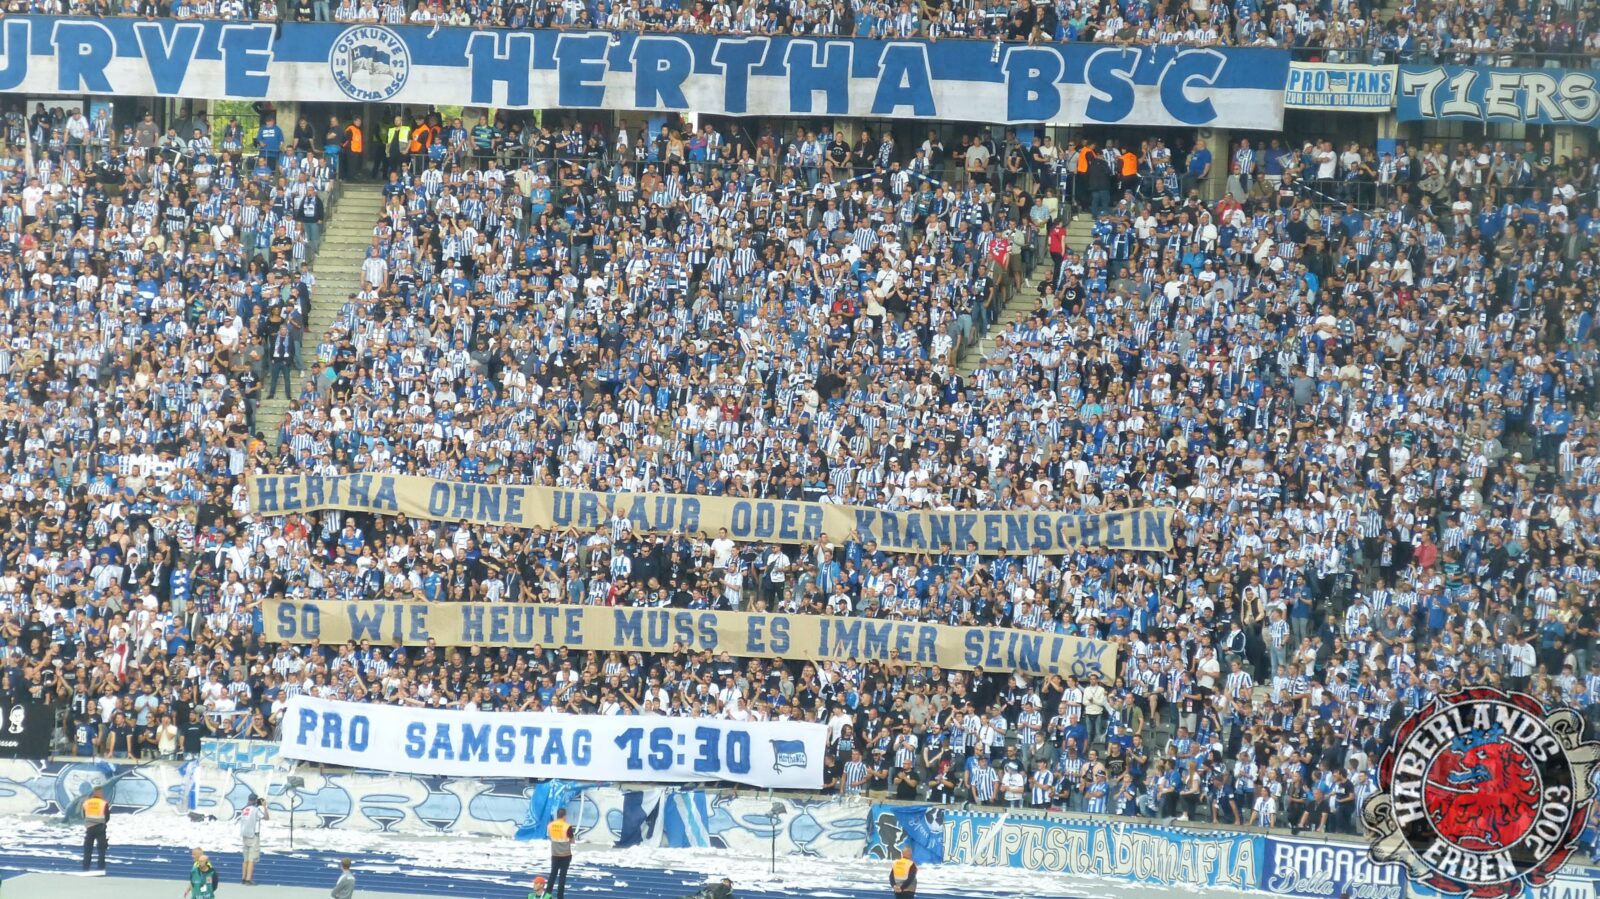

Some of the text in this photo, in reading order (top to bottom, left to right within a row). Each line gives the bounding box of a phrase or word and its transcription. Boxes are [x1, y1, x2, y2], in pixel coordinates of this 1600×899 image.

[338, 29, 402, 55] OSTKURVE
[336, 70, 404, 99] HERTHA BSC
[465, 31, 938, 118] HERTHA
[1001, 46, 1227, 124] BSC
[1289, 70, 1391, 93] PRO FANS
[1402, 66, 1600, 123] 71ERS
[256, 474, 1174, 554] HERTHA OHNE URLAUB ODER KRANKENSCHEIN
[276, 602, 1064, 673] SO WIE HEUTE MUSS ES IMMER SEIN!
[296, 707, 752, 775] PRO SAMSTAG 15:30
